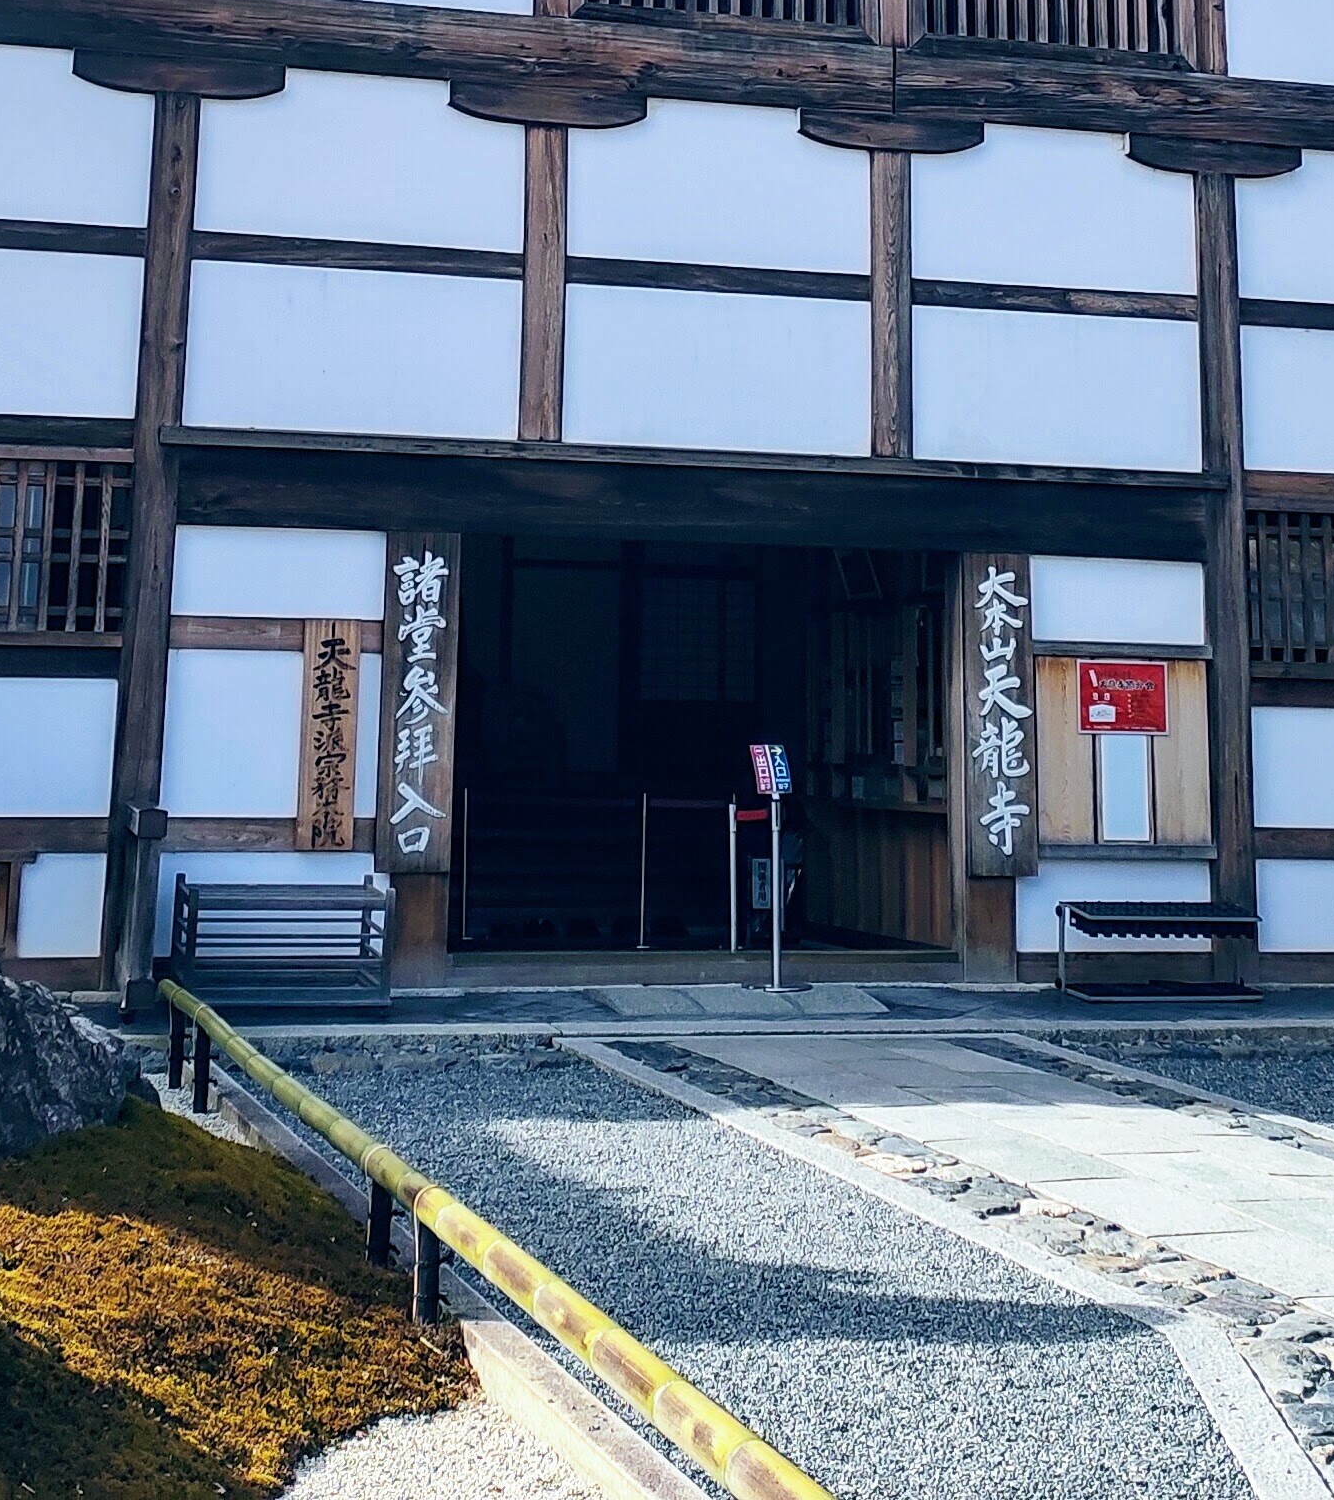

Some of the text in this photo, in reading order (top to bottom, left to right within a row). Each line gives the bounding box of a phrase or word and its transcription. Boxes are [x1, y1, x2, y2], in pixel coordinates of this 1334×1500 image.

[971, 565, 1033, 857] 大本山天龍寺
[755, 755, 770, 777] 出口
[774, 755, 787, 777] 入口
